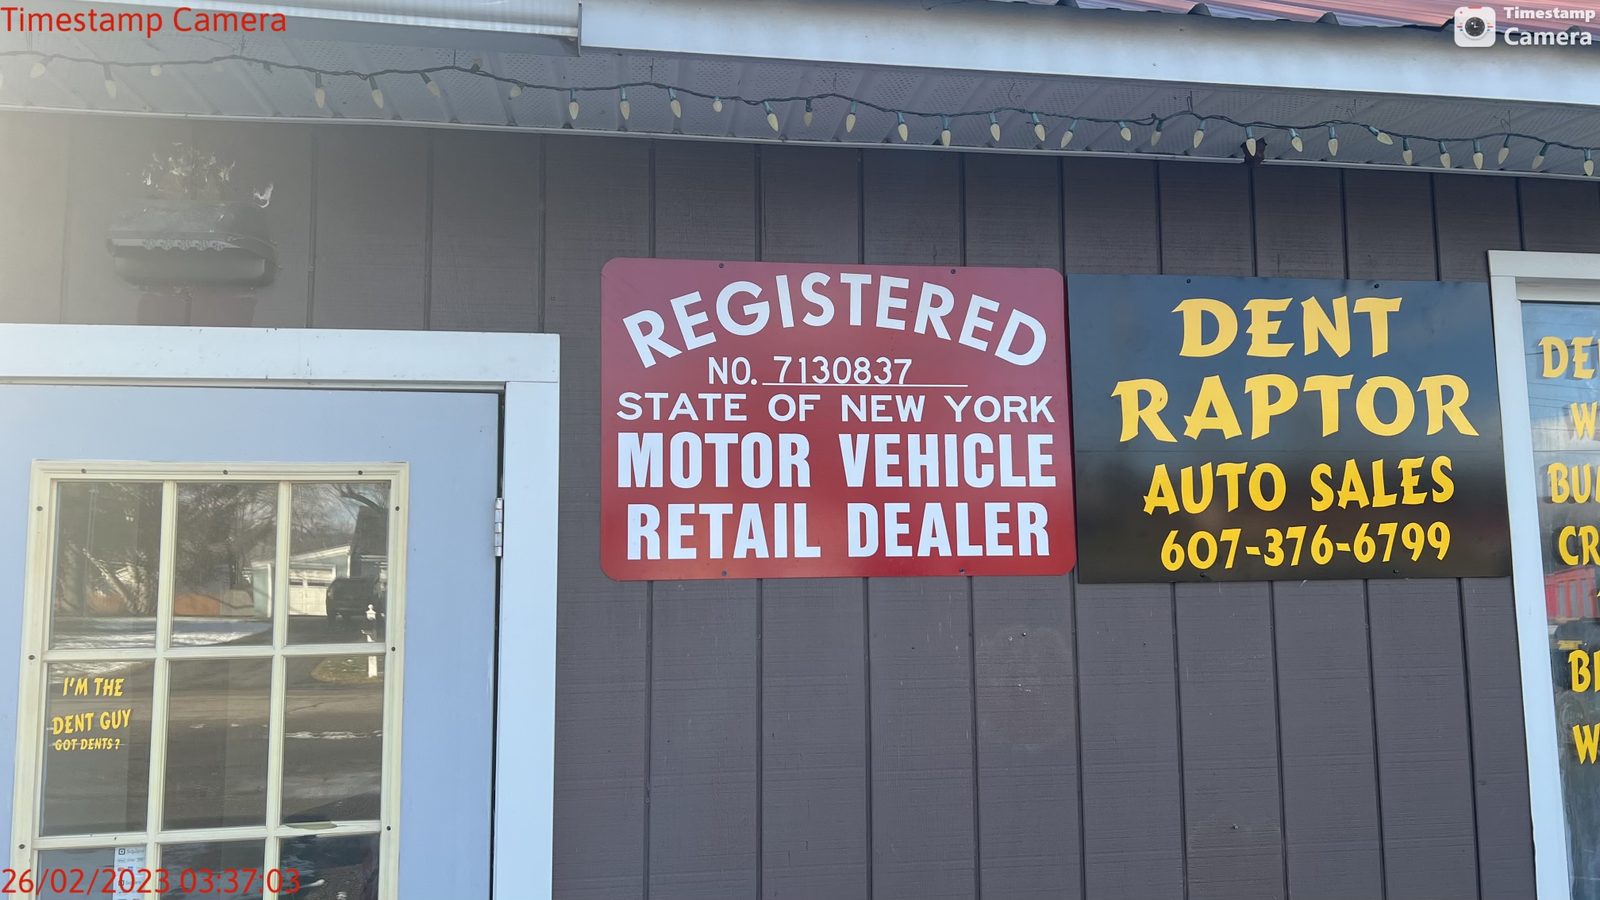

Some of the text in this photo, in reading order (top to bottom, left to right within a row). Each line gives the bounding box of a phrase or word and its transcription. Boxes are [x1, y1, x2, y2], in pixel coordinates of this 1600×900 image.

[622, 272, 1047, 368] REGISTERED
[1171, 296, 1402, 358] DENT
[708, 355, 913, 386] NO. 7130837
[1538, 336, 1600, 379] DE
[616, 391, 1055, 423] STATE OF NEW YORK
[1111, 374, 1479, 443] RAPTOR
[617, 431, 1056, 488] MOTOR VEHICLE
[1143, 456, 1455, 515] AUTO SALES
[1547, 462, 1600, 504] BU
[627, 502, 1050, 560] RETAIL DEALER
[1160, 521, 1452, 572] 607-376-6799
[62, 677, 125, 697] I'M THE
[1568, 649, 1600, 693] B
[52, 708, 131, 735] DENT GUY
[55, 738, 77, 751] GOT
